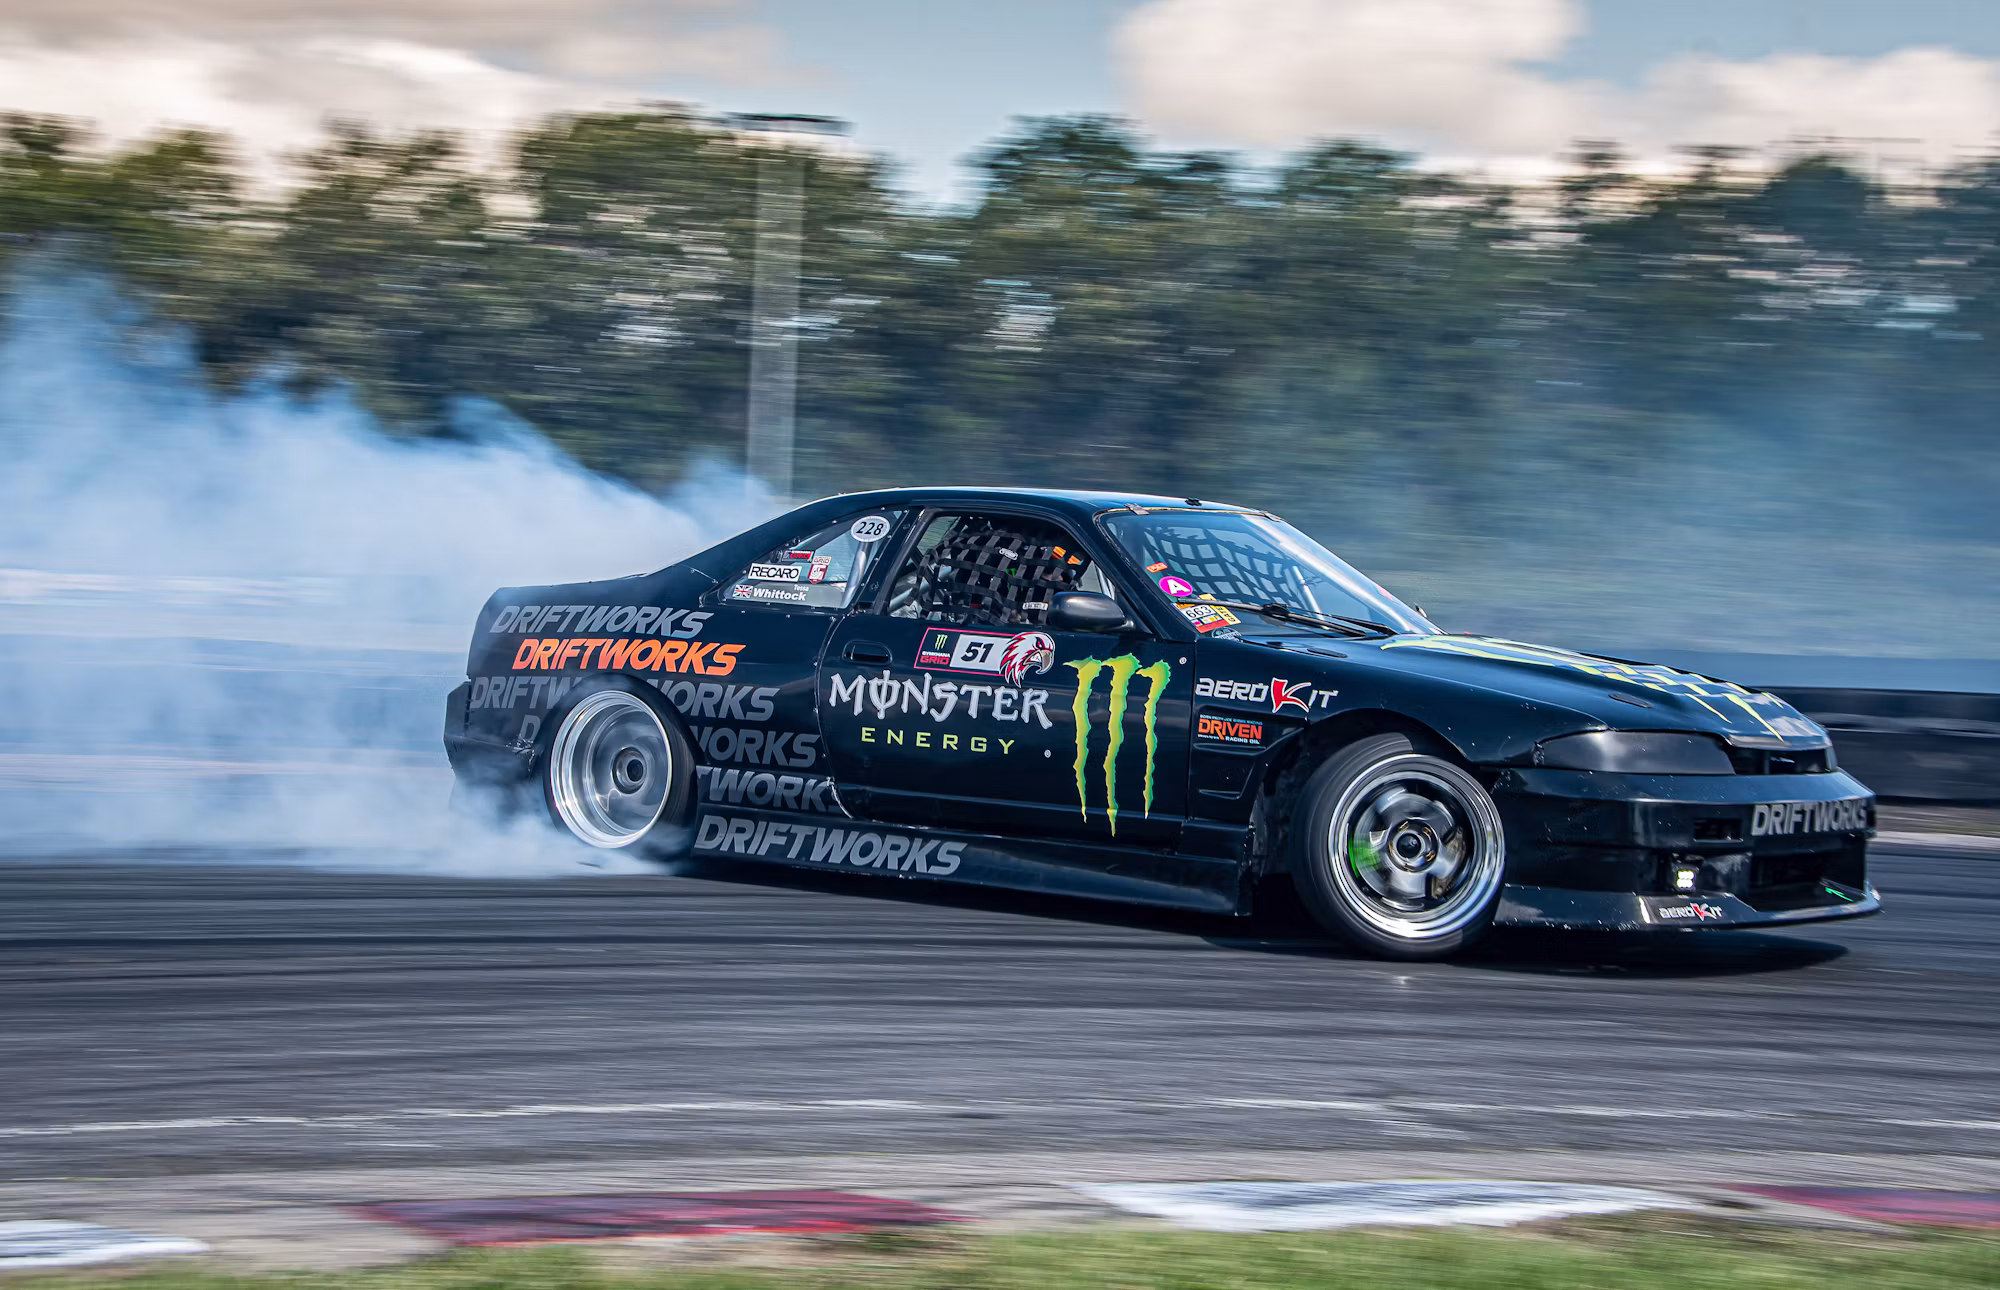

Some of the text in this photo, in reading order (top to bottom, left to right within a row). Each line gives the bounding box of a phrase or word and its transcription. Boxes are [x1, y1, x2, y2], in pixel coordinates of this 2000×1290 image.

[855, 521, 884, 536] 228
[750, 566, 799, 579] RECARO
[753, 588, 807, 601] Whittock
[793, 584, 810, 592] Tessa
[1166, 579, 1191, 595] A
[1185, 605, 1213, 619] 663
[490, 605, 714, 639] DRIFTWORKS
[512, 638, 746, 676] DRIFTWORKS
[920, 655, 949, 665] GRID
[960, 641, 995, 663] 51
[1198, 718, 1263, 741] DRIVEN
[861, 727, 1015, 754] ENERGY
[1225, 736, 1249, 744] RACING
[1752, 799, 1867, 836] DRIFTWORKS
[693, 815, 968, 875] DRIFTWORKS
